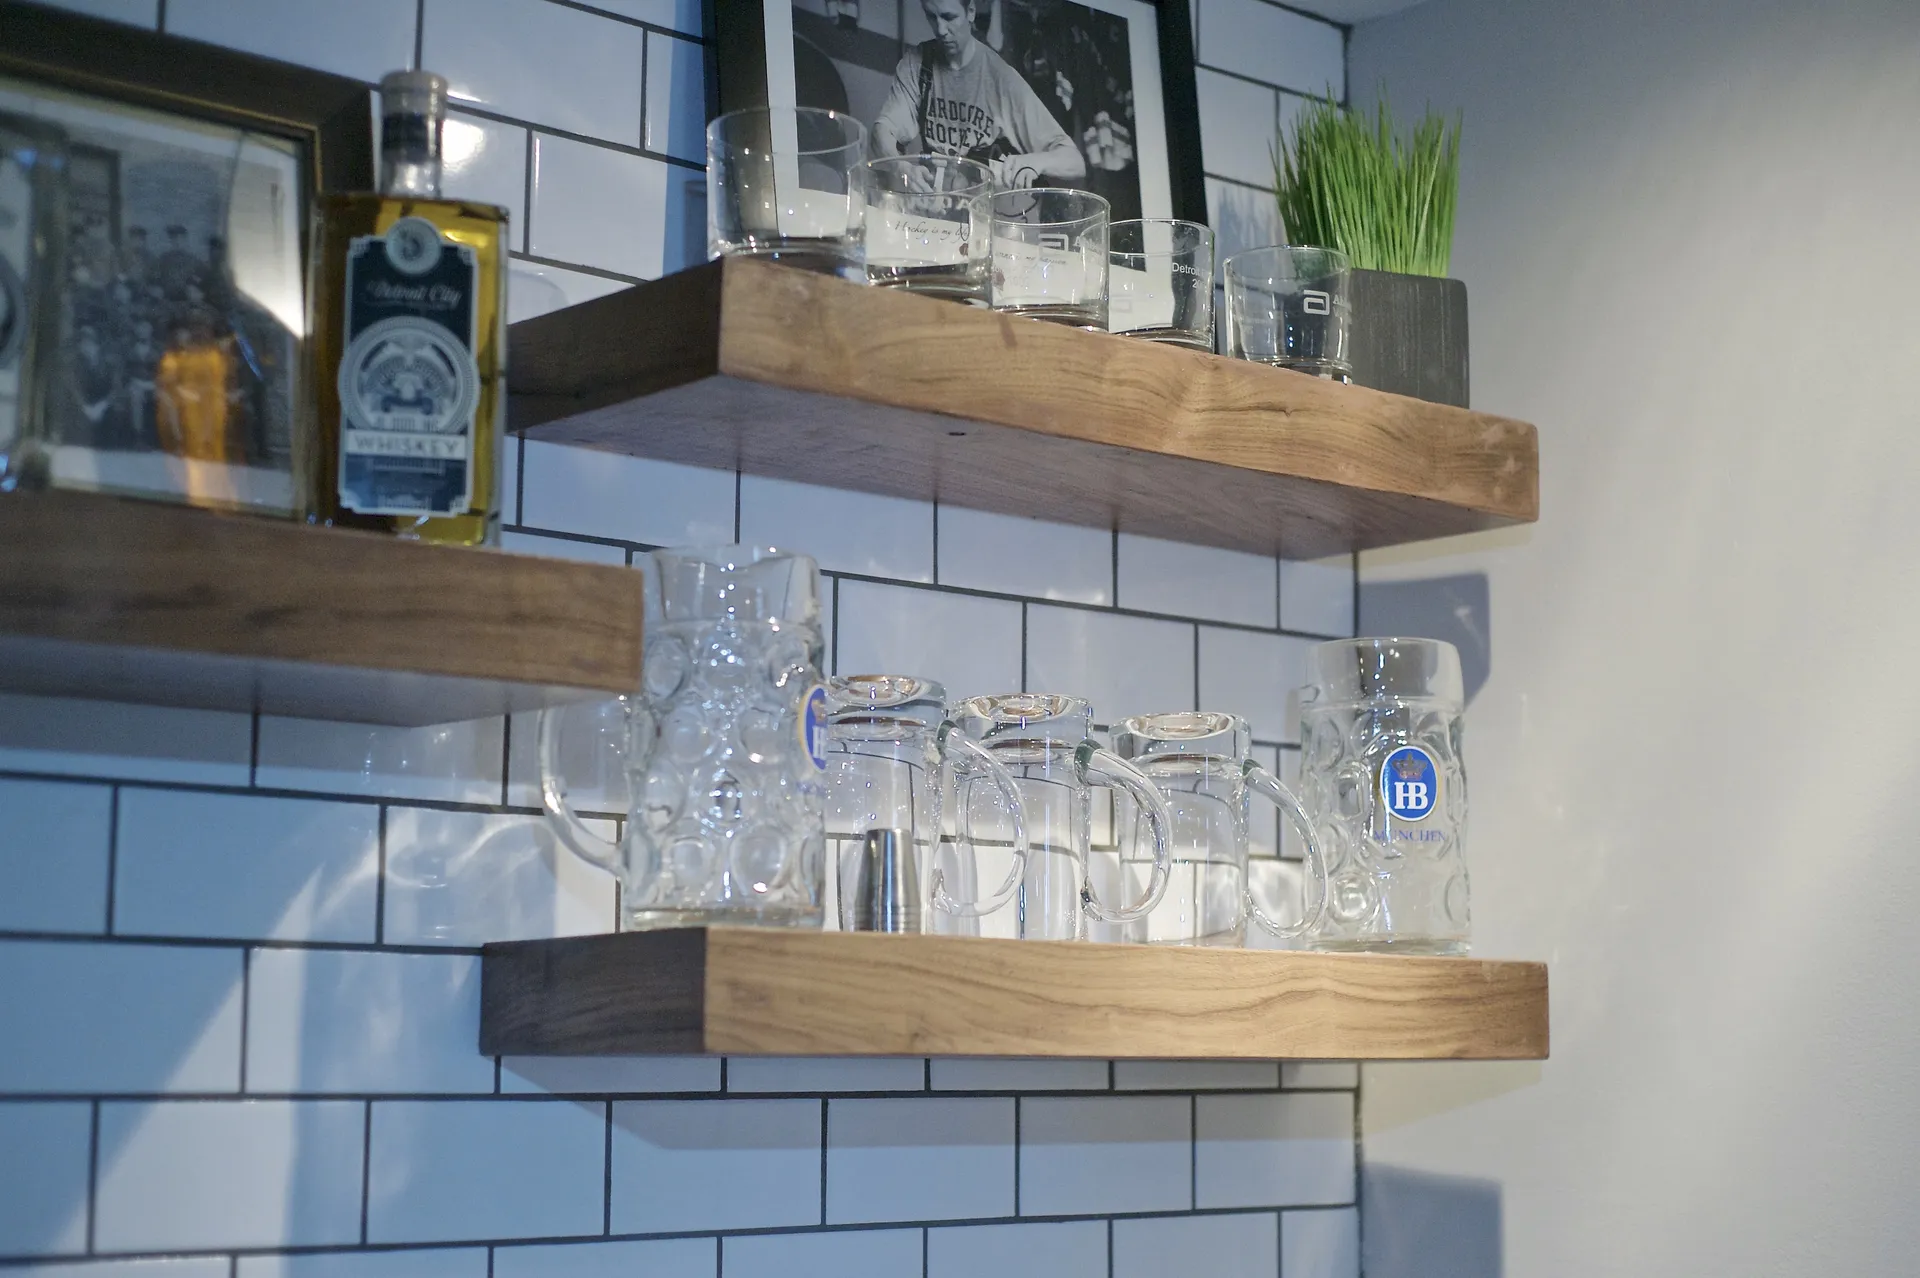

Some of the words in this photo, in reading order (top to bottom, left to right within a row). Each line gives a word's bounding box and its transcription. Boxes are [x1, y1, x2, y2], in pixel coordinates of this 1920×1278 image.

[927, 97, 995, 138] ARDCORE
[925, 119, 985, 149] HOCKEY
[355, 434, 459, 457] WHISKEY
[811, 724, 826, 759] H
[1394, 782, 1429, 810] HB
